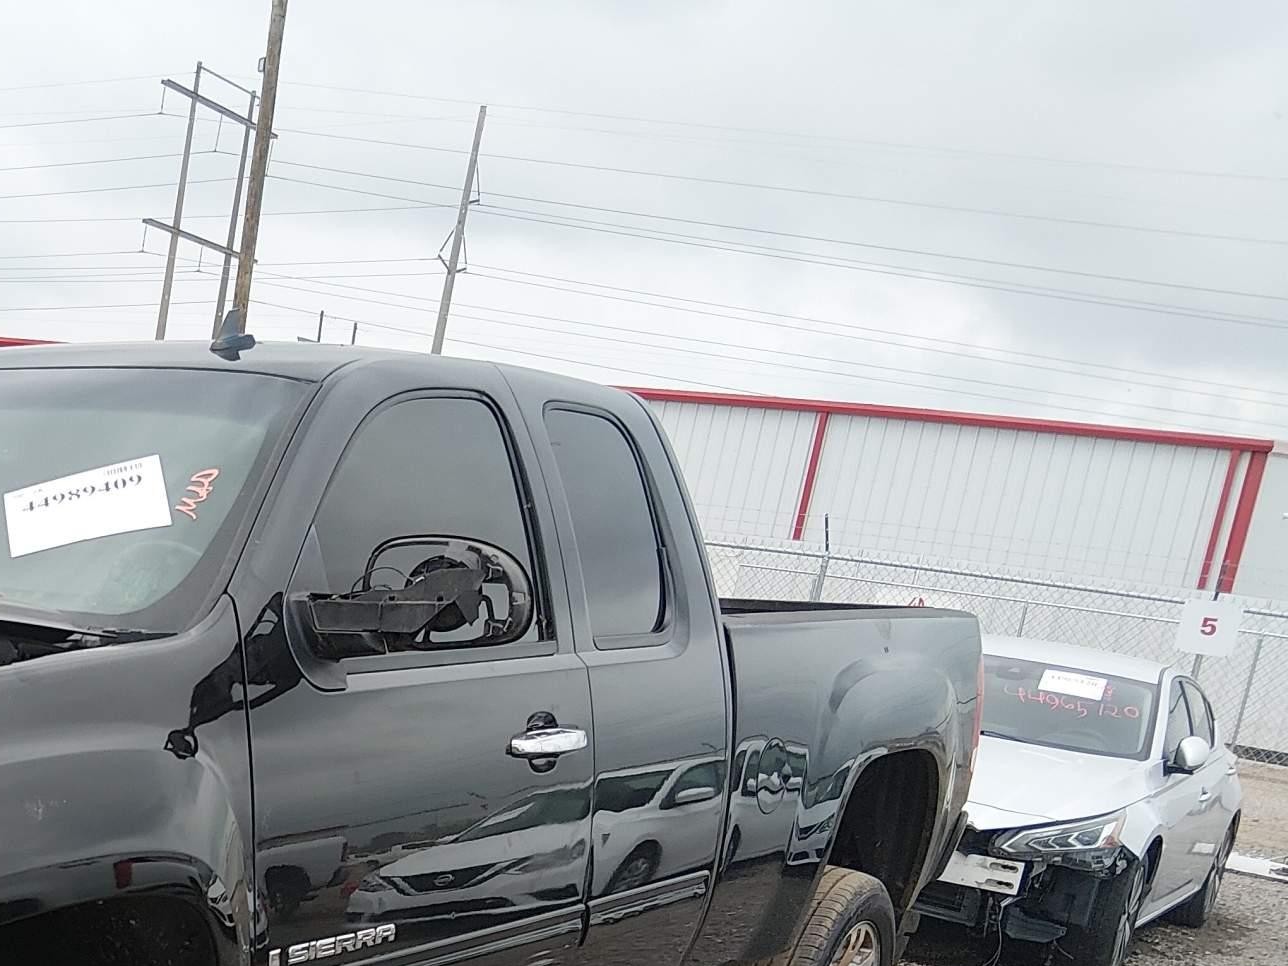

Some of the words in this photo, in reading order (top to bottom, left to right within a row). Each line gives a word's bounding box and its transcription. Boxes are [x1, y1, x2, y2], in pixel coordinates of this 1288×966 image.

[21, 474, 143, 513] 44989409
[1200, 617, 1218, 636] 5
[287, 923, 397, 966] SIERRA
